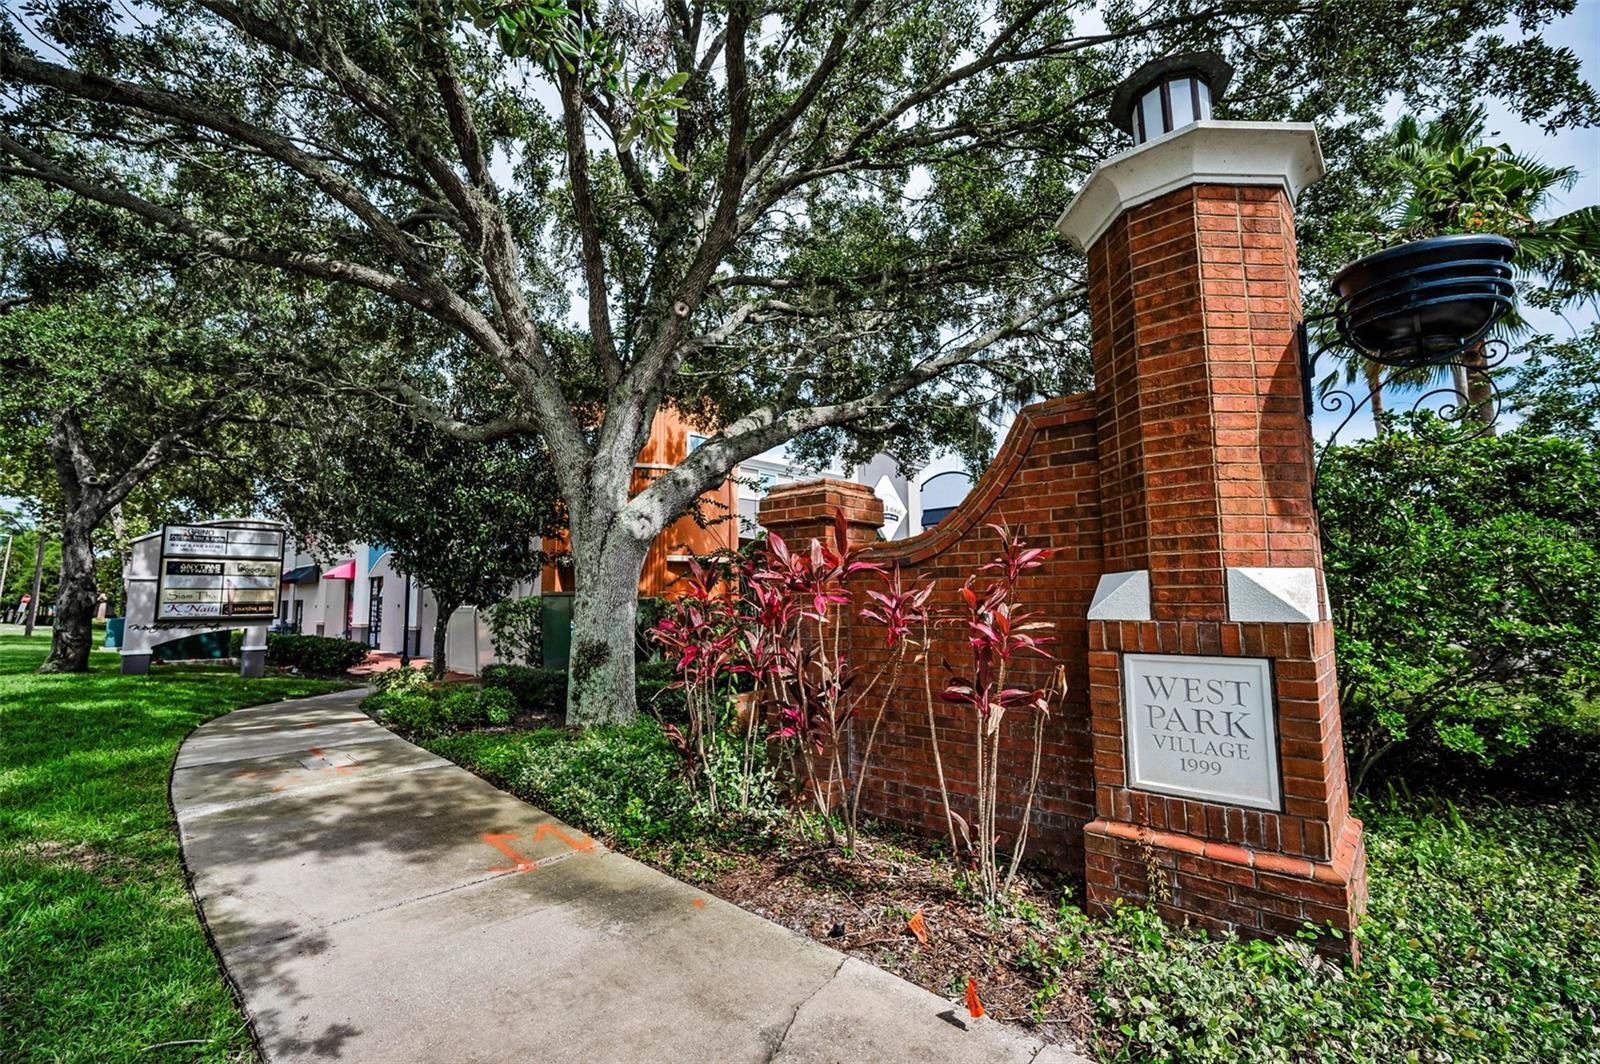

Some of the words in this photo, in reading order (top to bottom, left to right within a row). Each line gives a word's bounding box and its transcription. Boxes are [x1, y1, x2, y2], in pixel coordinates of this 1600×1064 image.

[166, 590, 193, 600] Siam
[195, 590, 217, 600] Tha
[165, 603, 182, 614] K
[184, 604, 219, 614] Nails
[1142, 674, 1251, 708] WEST
[1143, 704, 1255, 740] PARK
[1152, 734, 1251, 760] VILLAGE
[1180, 757, 1222, 776] 1999
